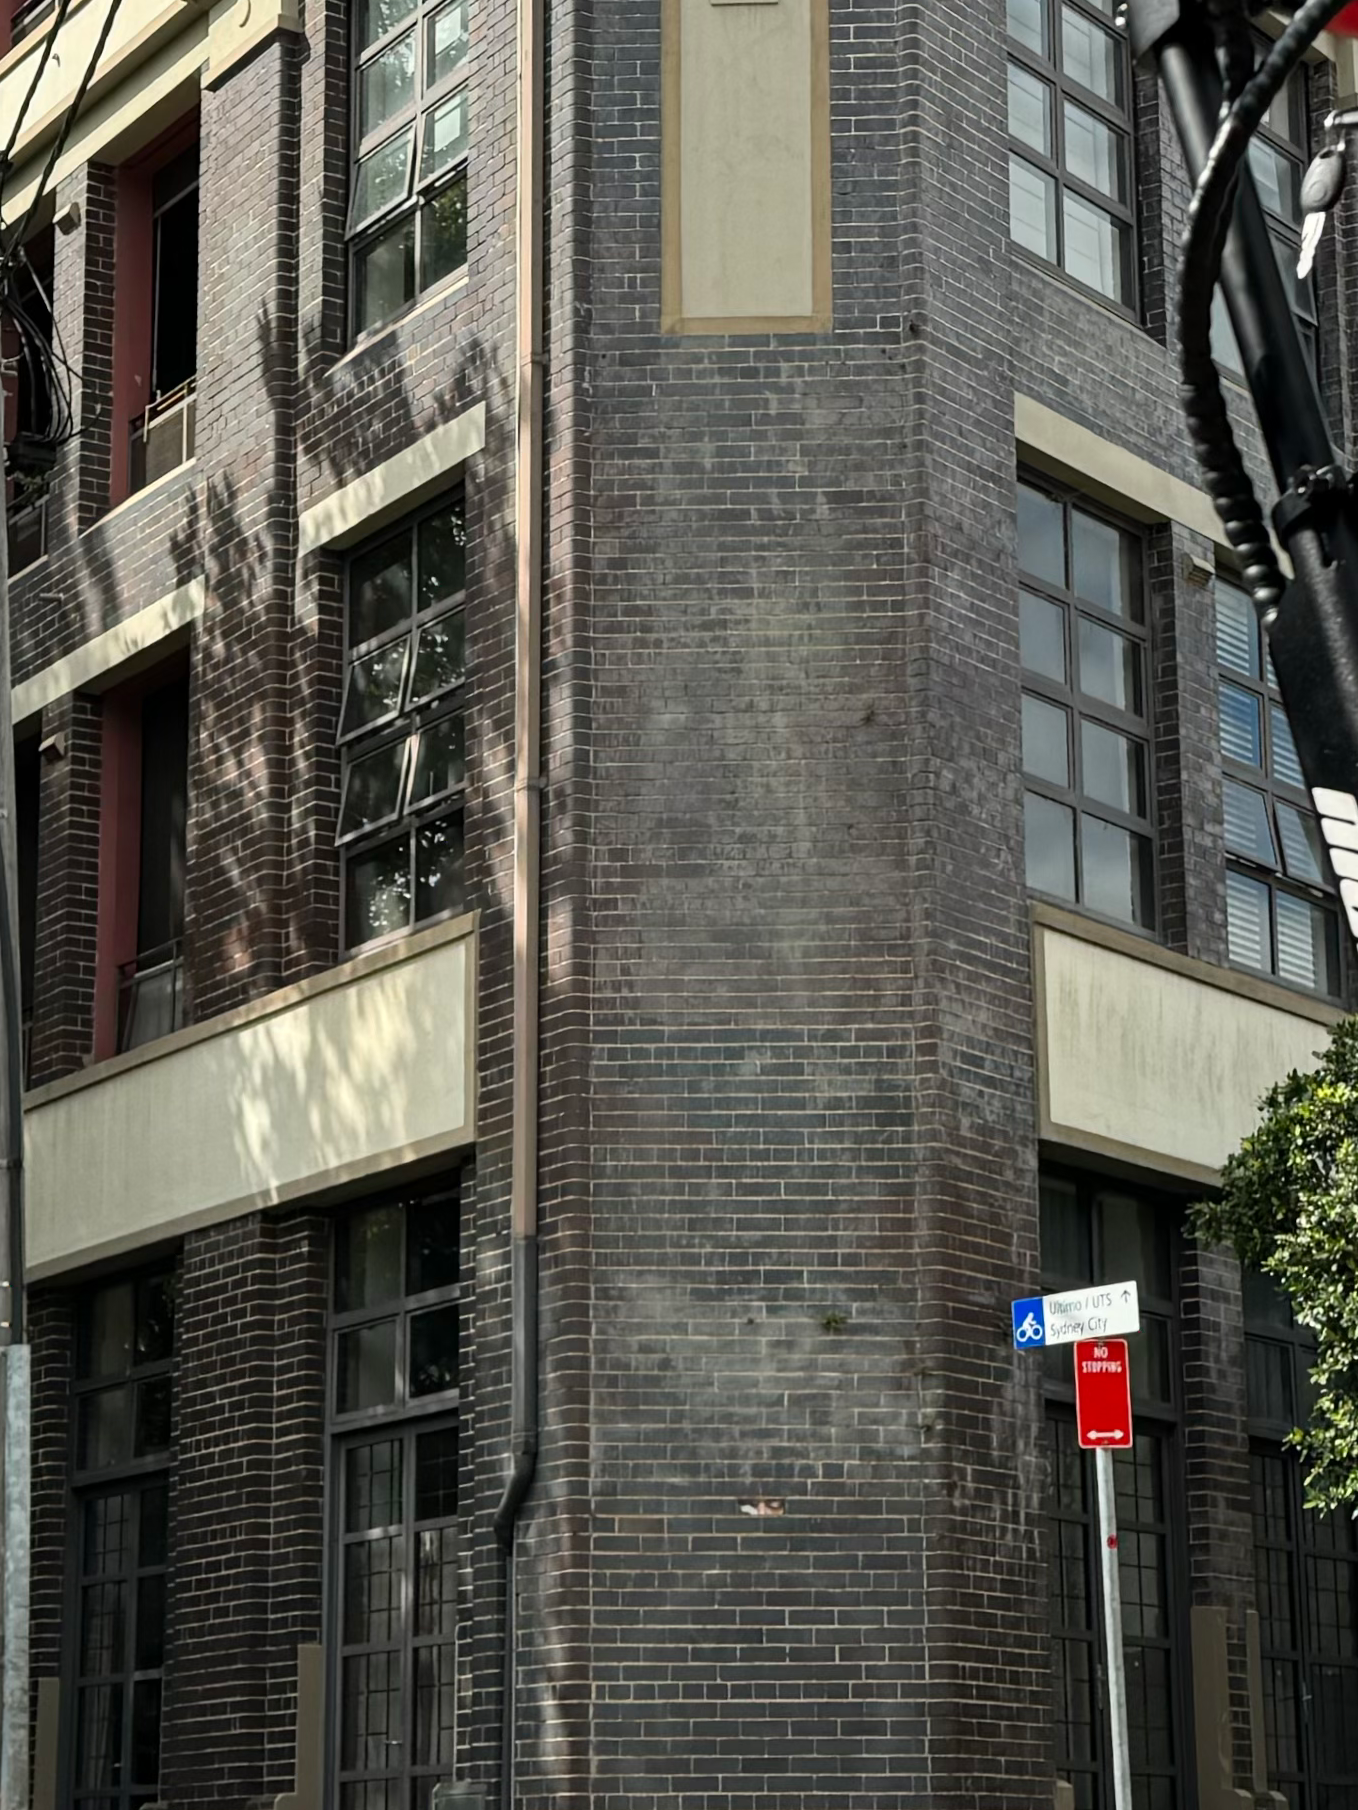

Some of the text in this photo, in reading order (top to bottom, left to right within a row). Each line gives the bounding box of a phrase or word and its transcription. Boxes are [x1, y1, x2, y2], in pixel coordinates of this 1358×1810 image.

[1092, 1293, 1111, 1308] UTS
[1050, 1317, 1107, 1339] Sydney City
[1093, 1346, 1109, 1359] NO
[1081, 1360, 1123, 1374] STOPPING
